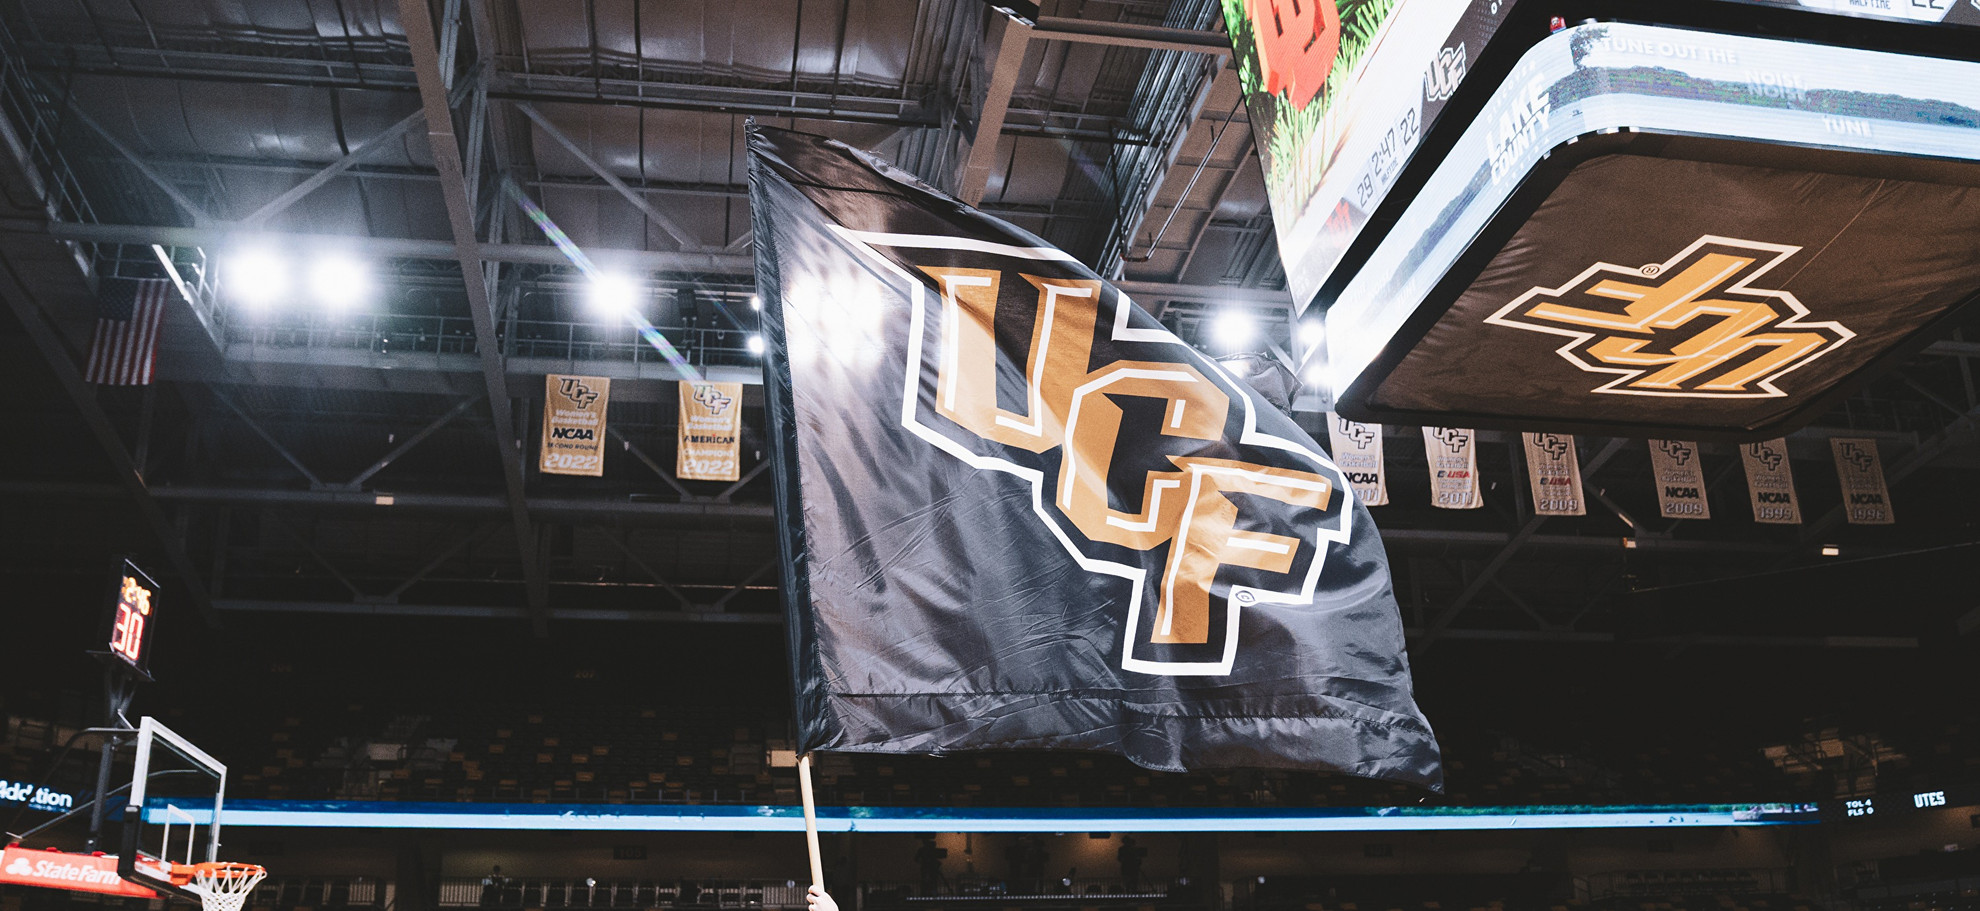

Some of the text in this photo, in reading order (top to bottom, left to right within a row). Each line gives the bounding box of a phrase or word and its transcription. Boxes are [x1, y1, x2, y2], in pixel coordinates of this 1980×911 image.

[1604, 38, 1739, 65] TUNE OUT THE
[1423, 42, 1466, 100] UCF
[1486, 72, 1550, 166] LAKE
[1357, 107, 1419, 209] 29 2:47 22
[1491, 103, 1551, 186] COUNTY
[1522, 252, 1829, 391] UCF
[560, 378, 598, 409] UCF
[693, 384, 732, 415] UCF
[552, 427, 594, 440] NCAA
[1338, 417, 1375, 449] UCF
[1432, 426, 1469, 453] UCF
[1533, 433, 1567, 460] UCF
[544, 452, 598, 470] 2022
[910, 264, 1335, 645] UCF
[1658, 440, 1692, 466] UCF
[1750, 442, 1782, 471] UCF
[1839, 442, 1873, 472] UCF
[683, 458, 735, 476] 2022
[1439, 491, 1473, 505] 2011
[1540, 499, 1579, 512] 2009
[1665, 485, 1699, 499] NCAA
[1757, 492, 1791, 504] NCAA
[1851, 493, 1884, 505] NCAA
[1666, 502, 1703, 515] 2009
[112, 603, 145, 660] 30
[1848, 808, 1864, 816] FLS
[1914, 791, 1945, 807] UTES
